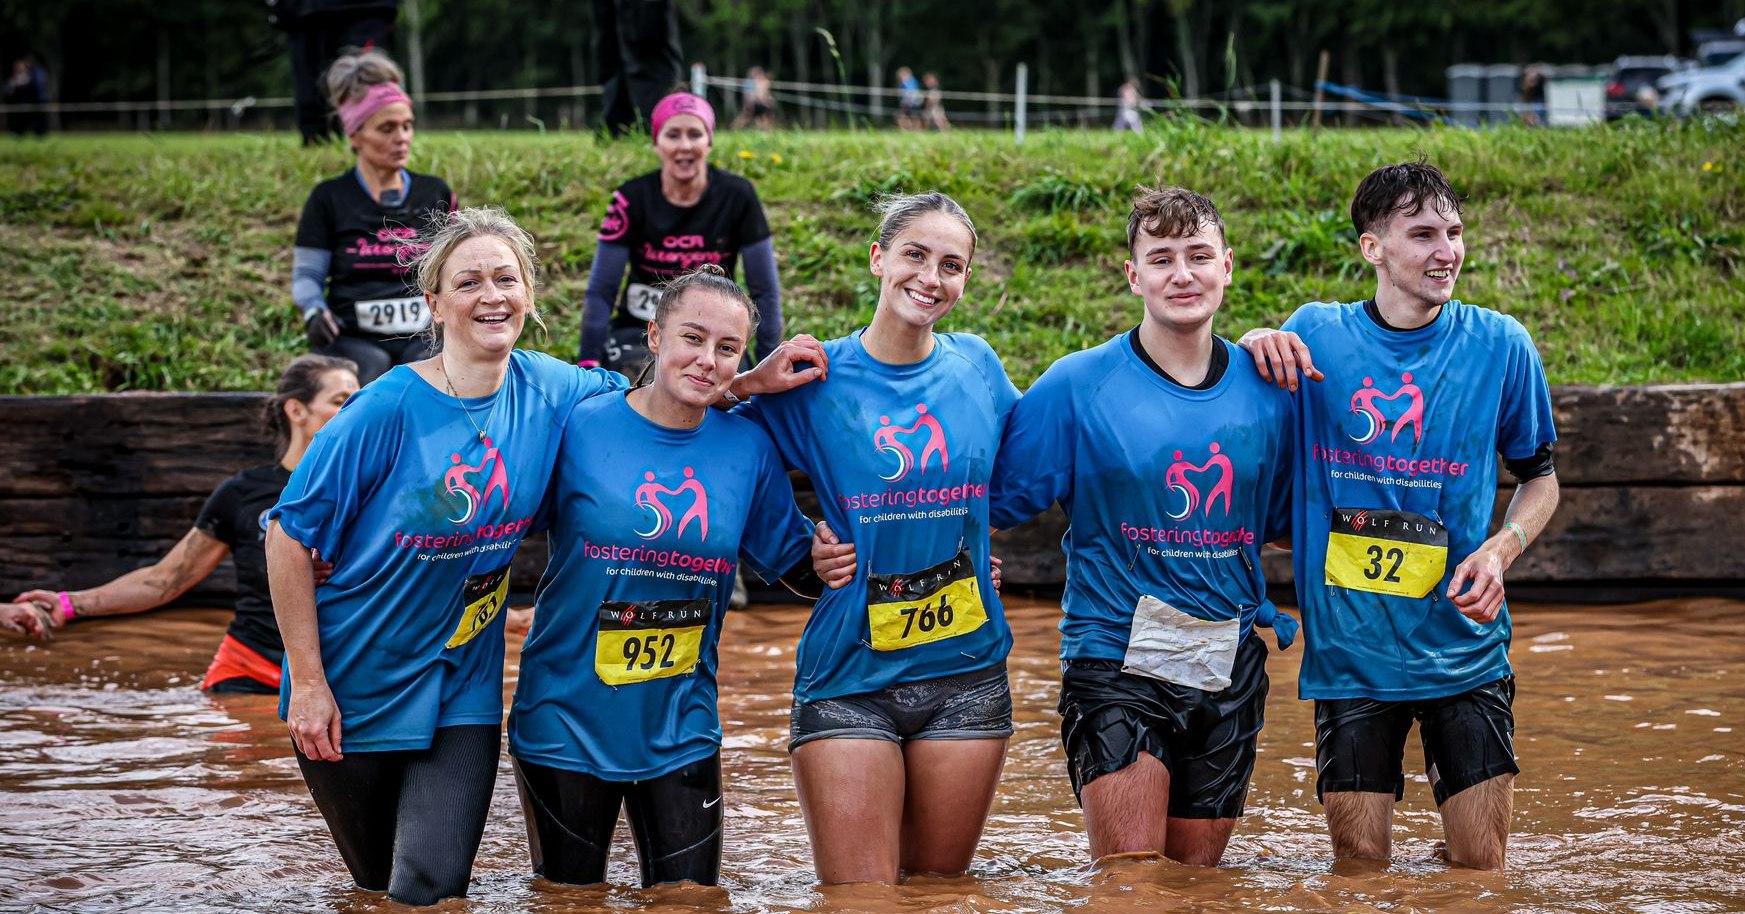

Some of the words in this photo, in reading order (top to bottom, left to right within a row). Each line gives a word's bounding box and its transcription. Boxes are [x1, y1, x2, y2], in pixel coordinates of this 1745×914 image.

[370, 302, 420, 326] 2919
[1330, 470, 1343, 479] for
[1344, 471, 1376, 482] children
[1376, 476, 1395, 485] with
[1396, 477, 1442, 489] disabilities
[859, 516, 871, 524] for
[874, 512, 907, 523] children
[908, 510, 927, 520] with
[1342, 514, 1389, 527] WOLF
[1402, 521, 1437, 536] RUN
[417, 553, 430, 561] for
[432, 552, 463, 561] children
[465, 546, 480, 556] with
[1147, 547, 1160, 555] for
[1161, 549, 1193, 558] children
[1364, 545, 1404, 583] 32
[606, 567, 619, 575] for
[620, 567, 654, 577] children
[656, 571, 675, 580] with
[879, 580, 925, 591] WOLF
[610, 611, 657, 620] WOLF
[668, 610, 701, 619] RUN
[900, 594, 954, 639] 766
[623, 634, 675, 671] 952
